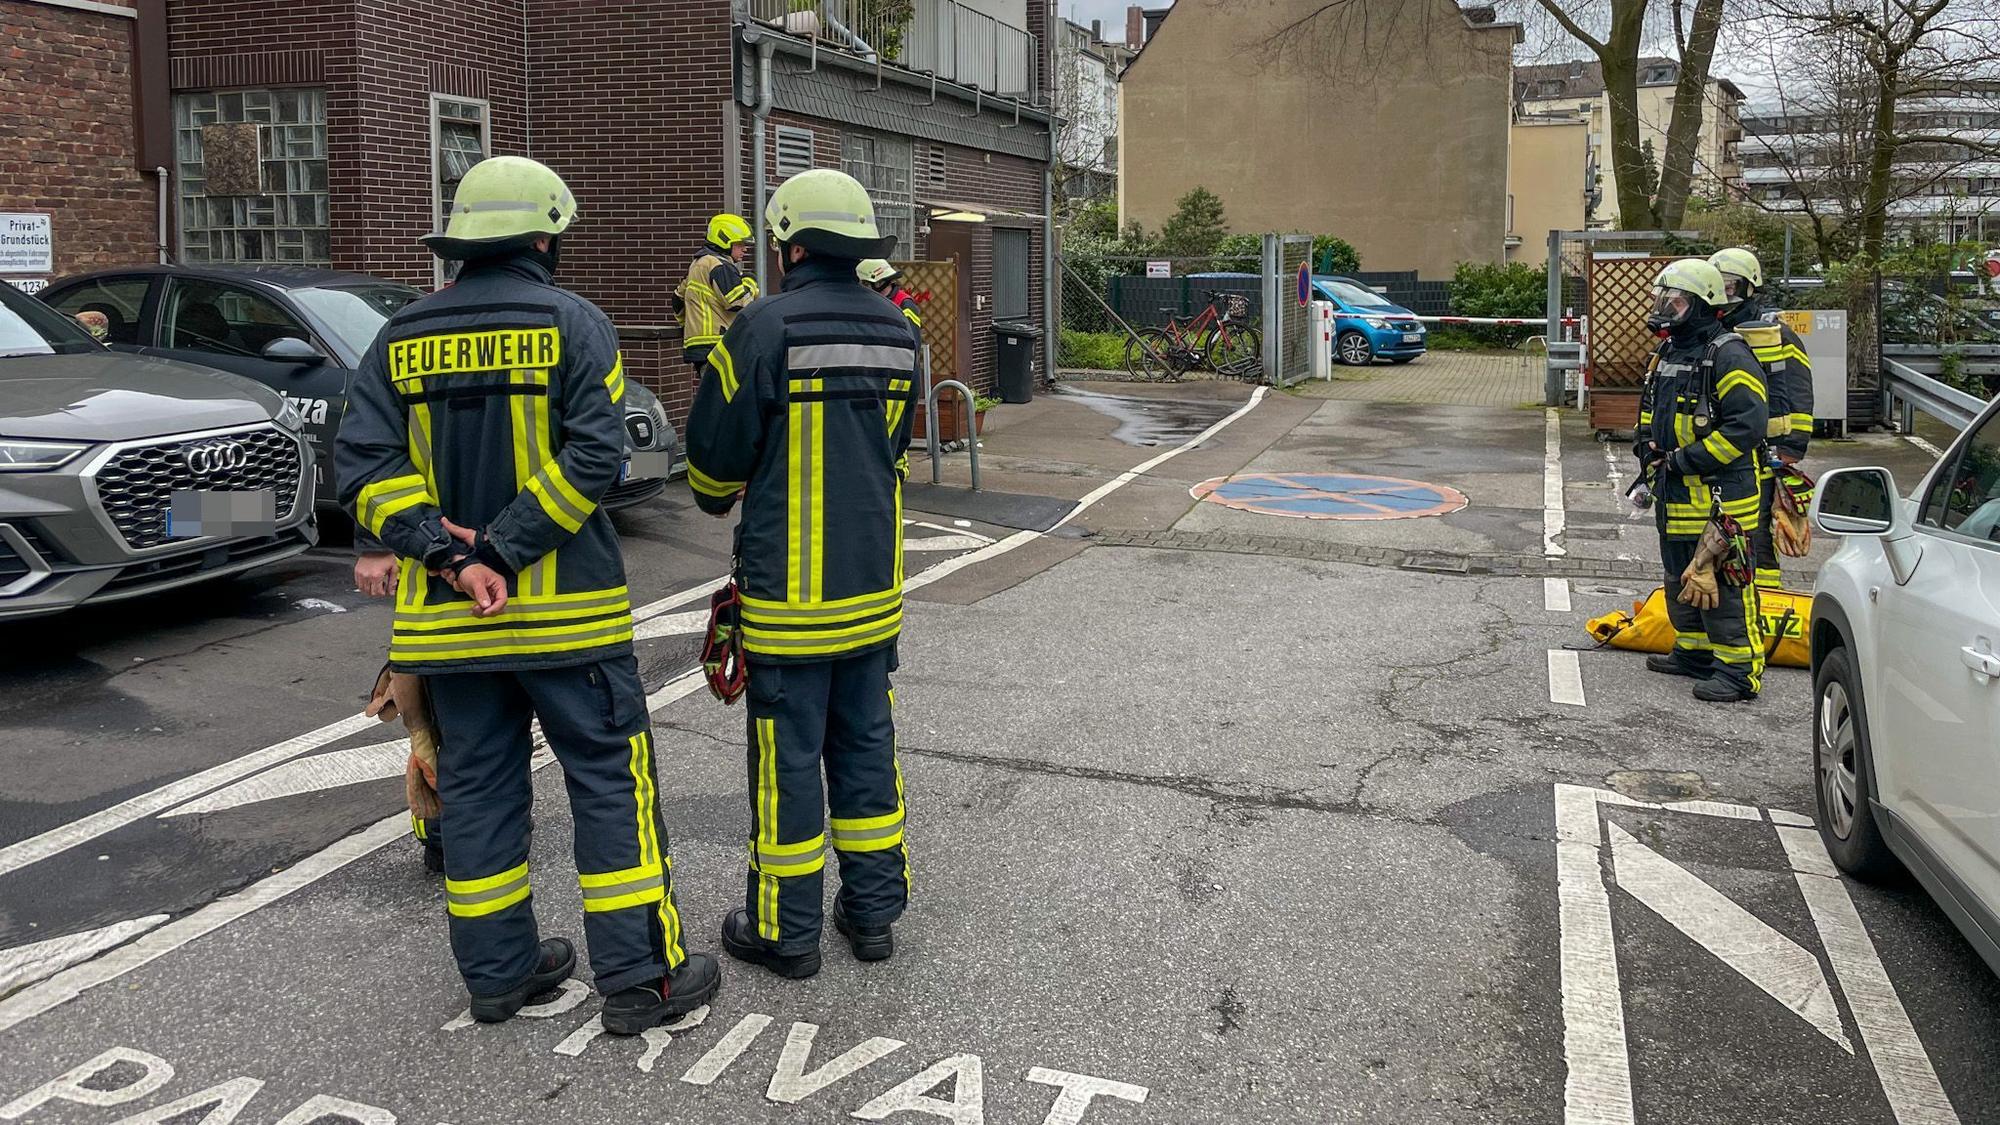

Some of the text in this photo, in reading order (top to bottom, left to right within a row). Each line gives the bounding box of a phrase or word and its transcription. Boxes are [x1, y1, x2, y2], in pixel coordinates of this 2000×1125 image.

[9, 220, 40, 231] Privat-
[0, 233, 49, 245] Grundstück
[394, 332, 554, 377] FEUERWEHR
[1760, 615, 1800, 635] ATZ
